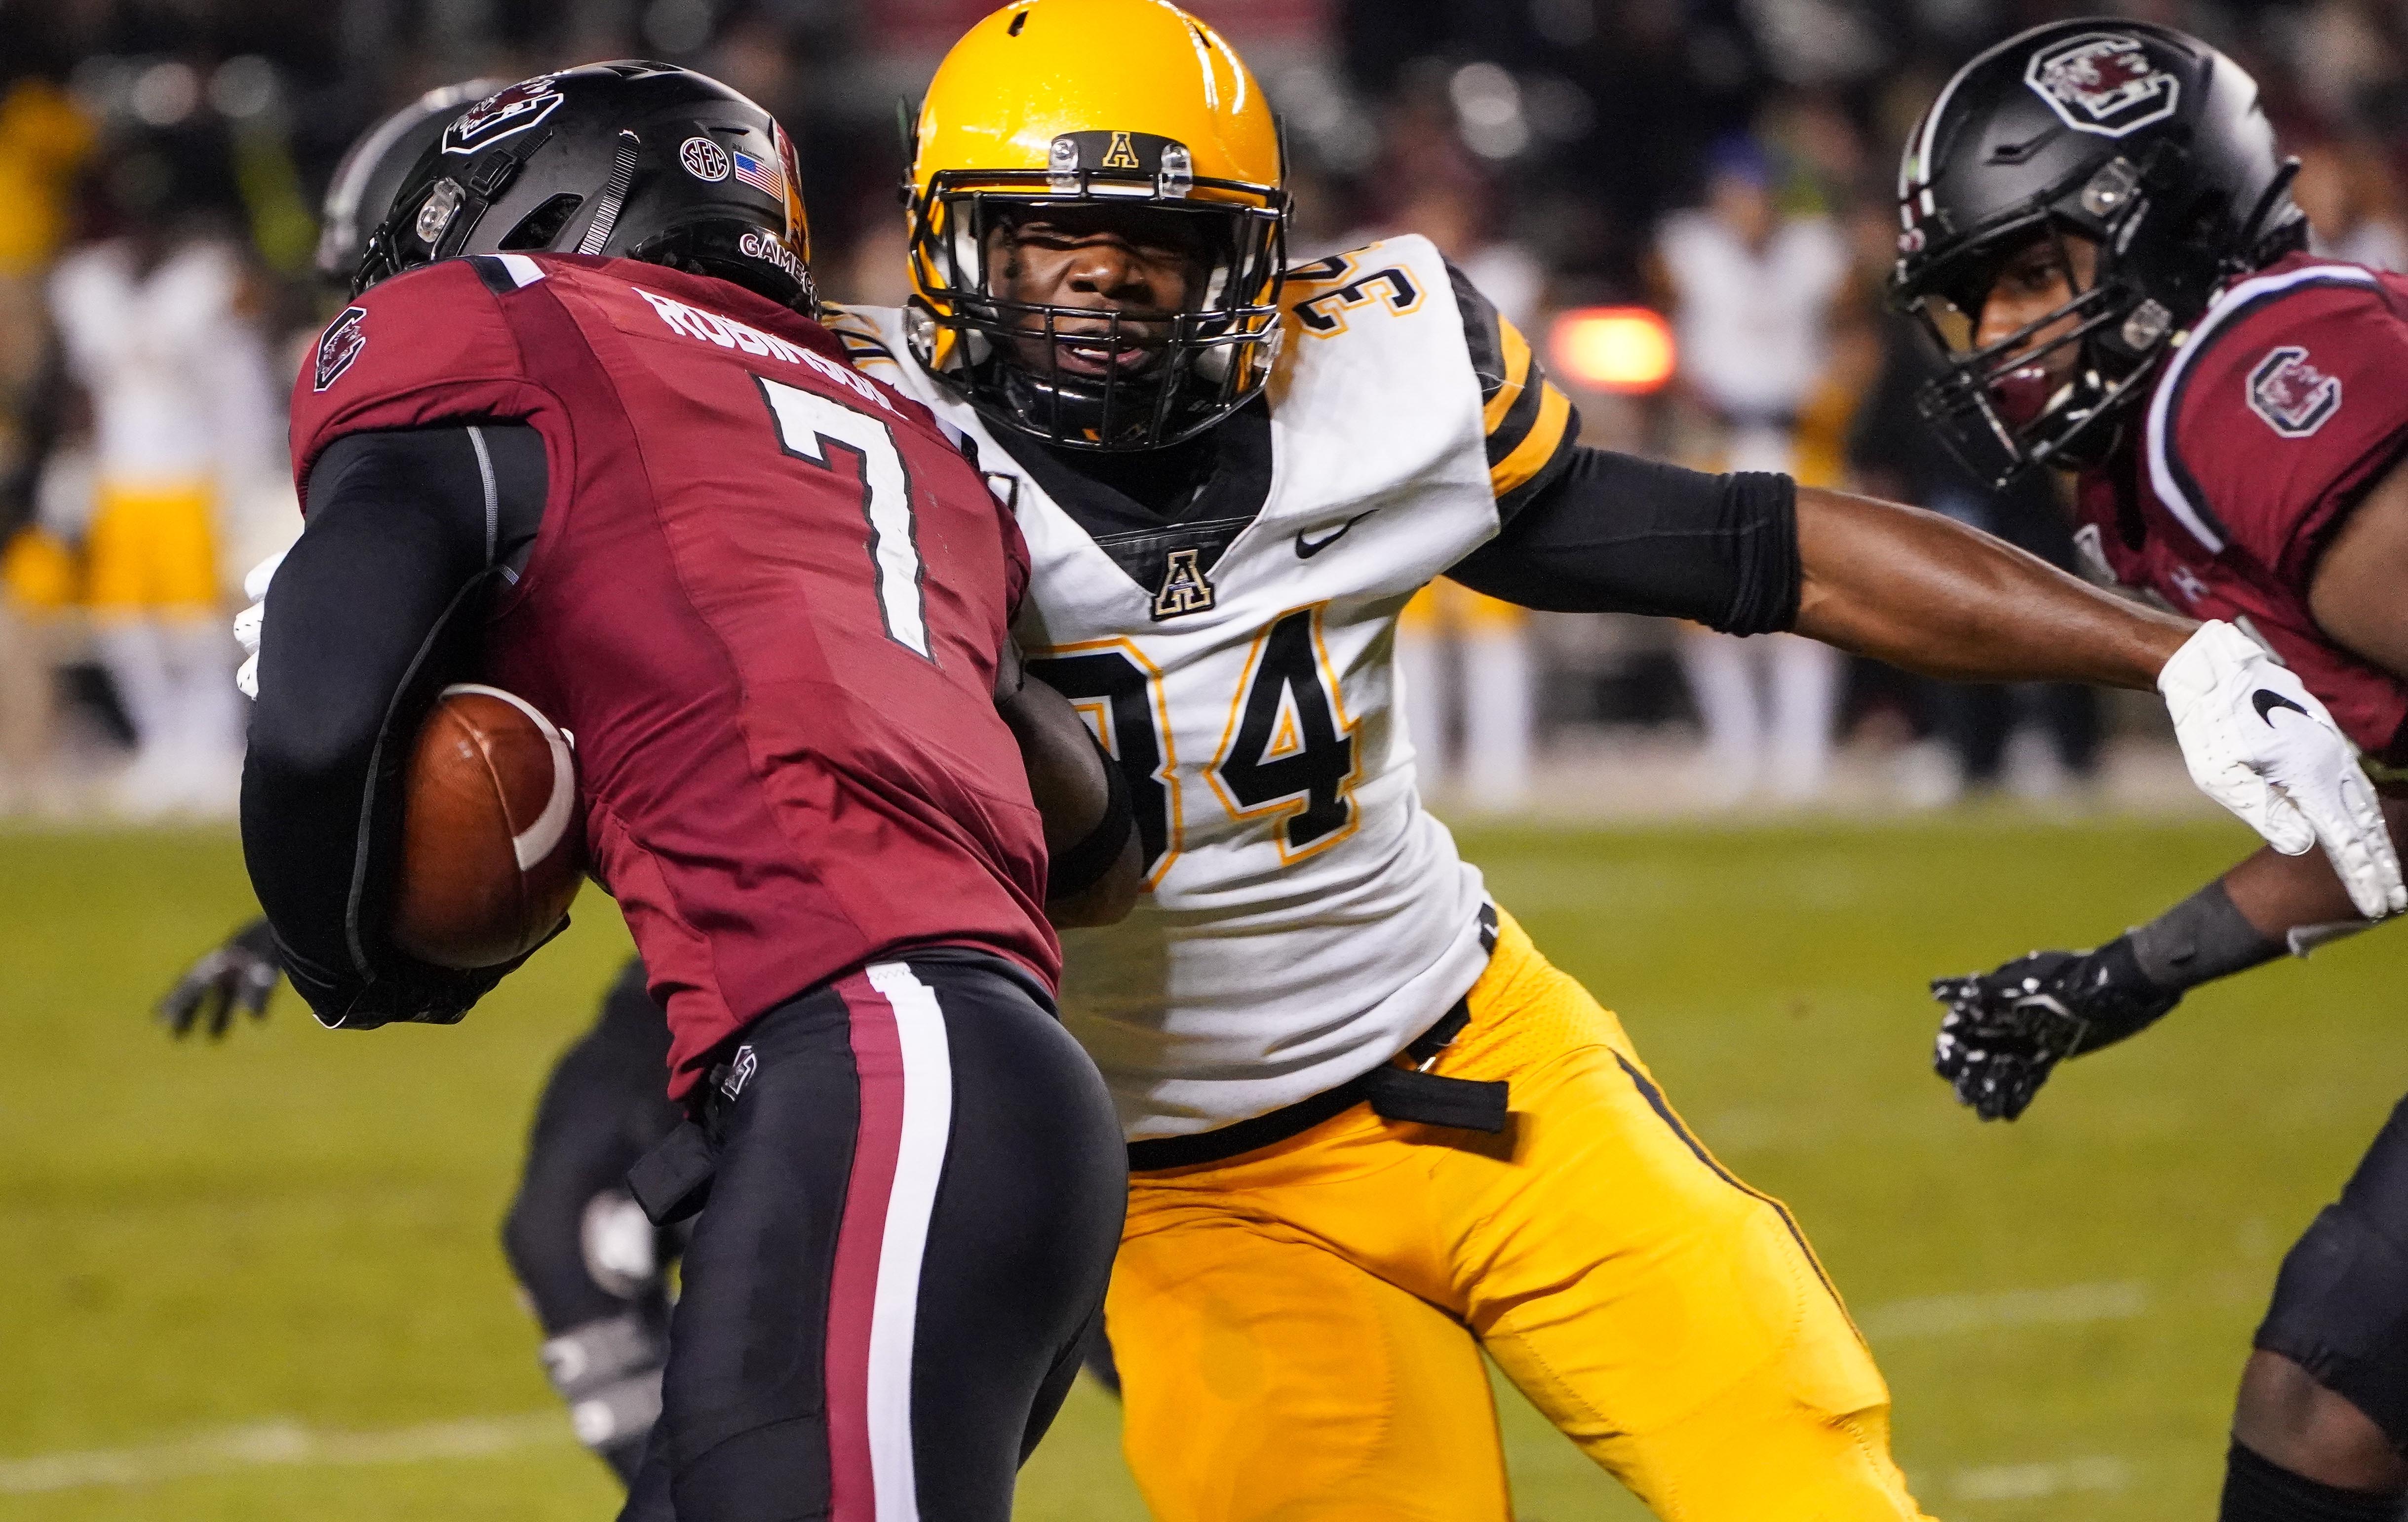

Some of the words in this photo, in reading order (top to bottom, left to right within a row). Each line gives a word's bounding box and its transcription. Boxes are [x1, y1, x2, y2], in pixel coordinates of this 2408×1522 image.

[680, 137, 730, 181] SEC
[1102, 131, 1139, 168] A
[752, 372, 936, 664] 7
[1154, 548, 1214, 617] A
